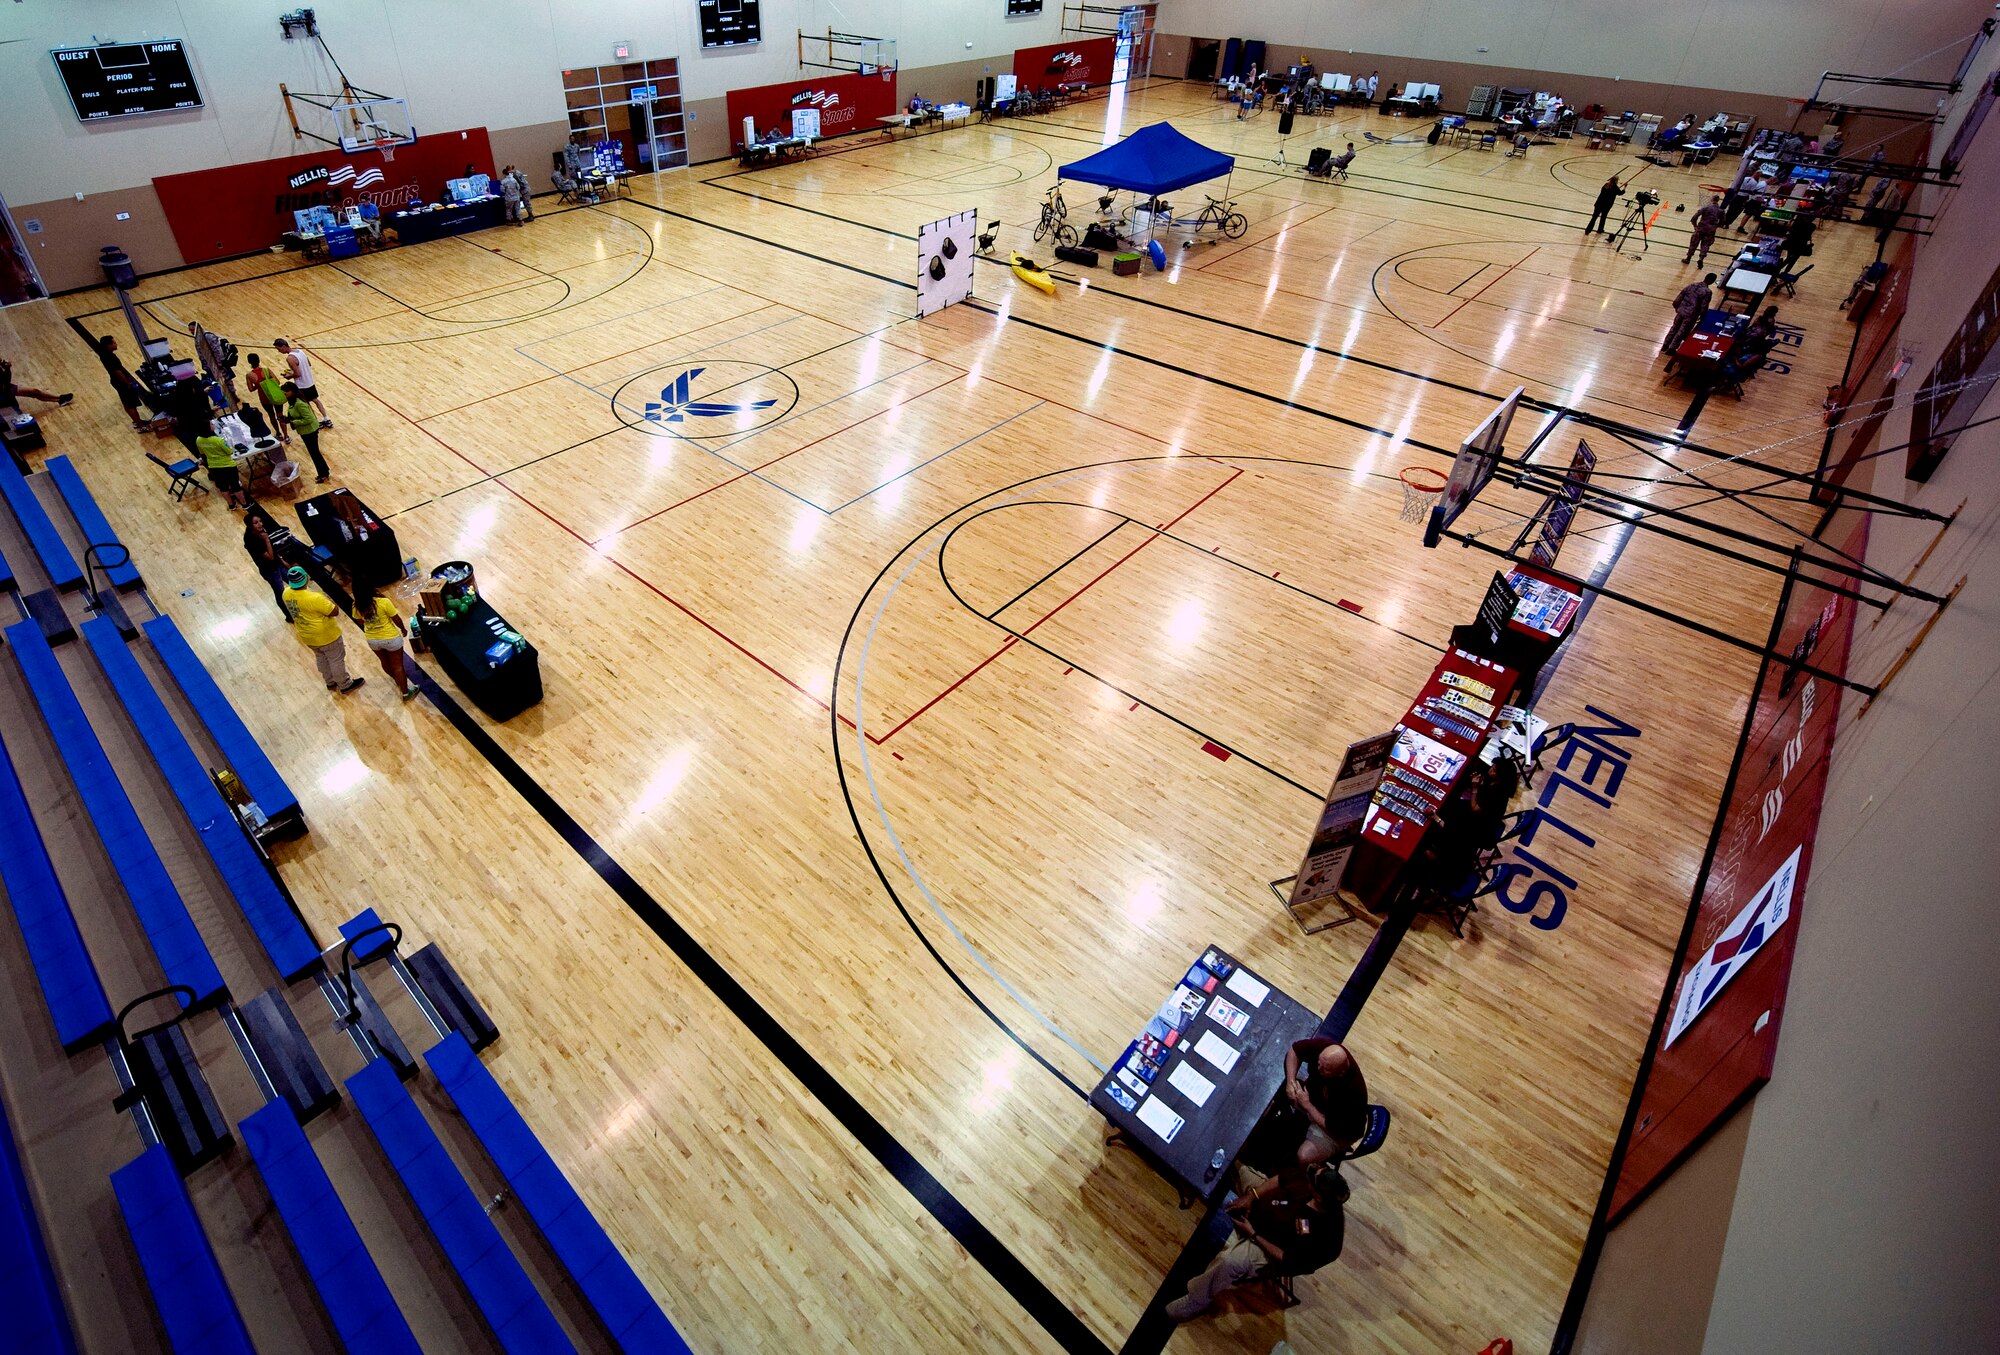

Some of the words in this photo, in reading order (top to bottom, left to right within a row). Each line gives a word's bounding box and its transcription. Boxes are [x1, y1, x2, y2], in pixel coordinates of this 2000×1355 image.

[152, 43, 177, 52] HOME
[59, 52, 89, 61] GUEST
[107, 73, 133, 82] PERIOD
[116, 86, 154, 95] PLAYER-FOUL
[792, 91, 812, 105] NELLIS
[88, 110, 109, 118] POINTS
[821, 106, 856, 126] Sports
[290, 167, 329, 189] NELLIS
[1423, 752, 1448, 774] $150
[1496, 704, 1642, 931] NELLIS
[1771, 865, 1793, 924] NELLIS
